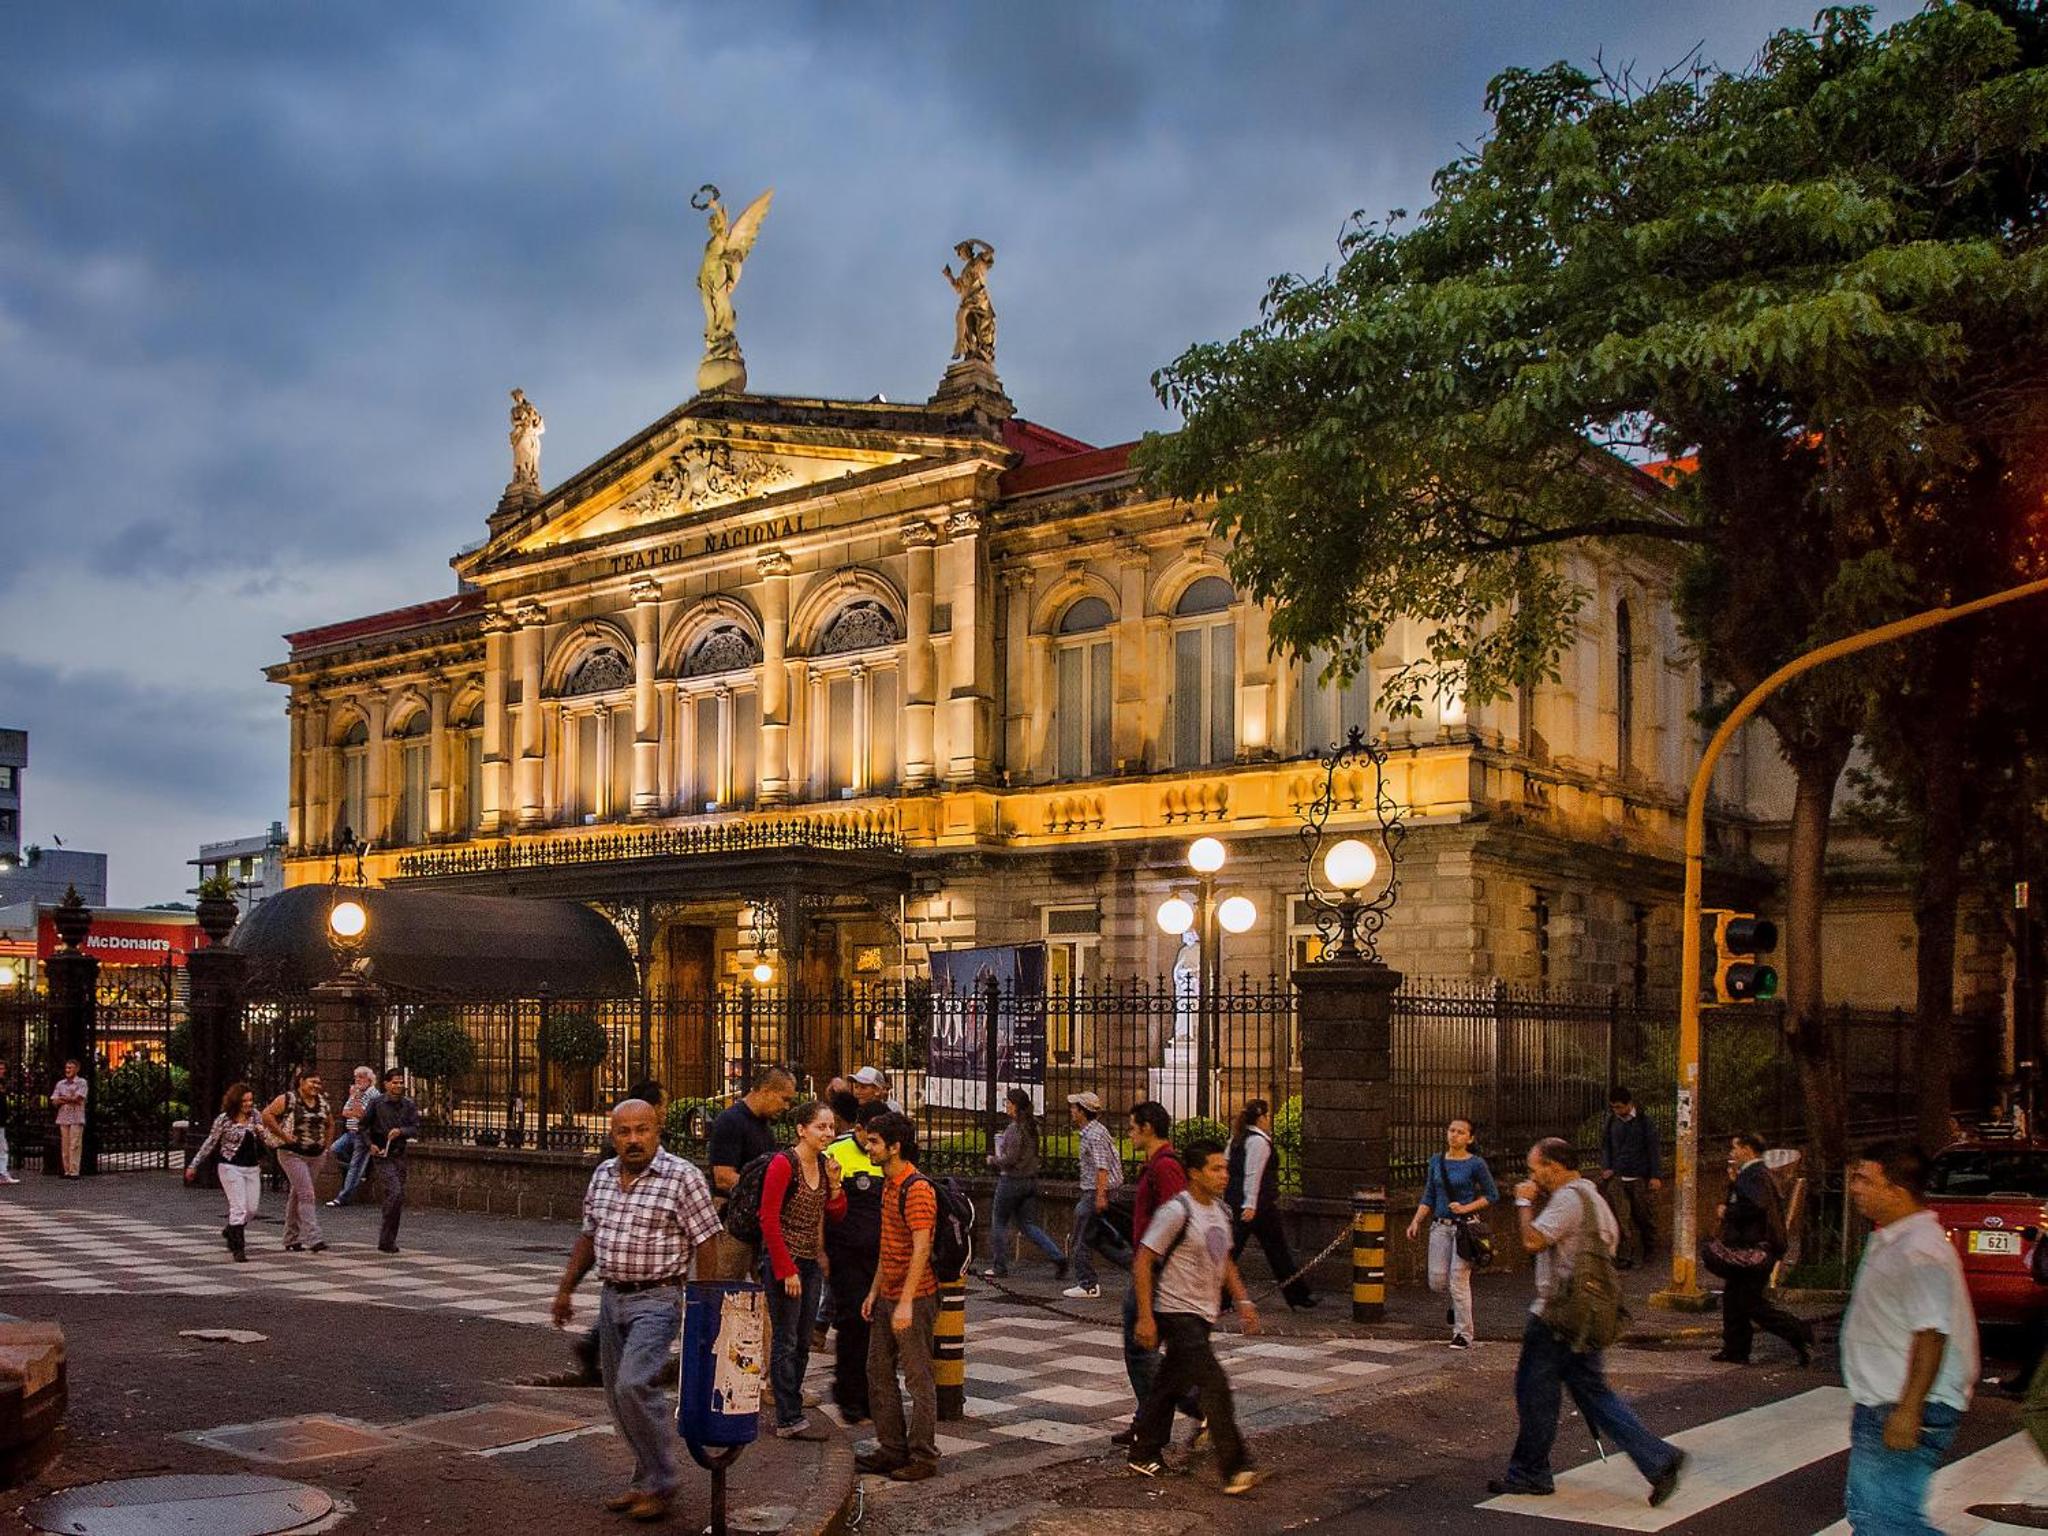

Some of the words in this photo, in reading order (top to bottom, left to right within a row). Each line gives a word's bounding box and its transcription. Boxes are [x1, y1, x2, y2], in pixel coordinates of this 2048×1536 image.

[610, 544, 682, 574] TEATRO
[704, 515, 807, 553] NACIONAL
[87, 935, 170, 951] McDonald's
[1988, 1236, 2008, 1249] 621
